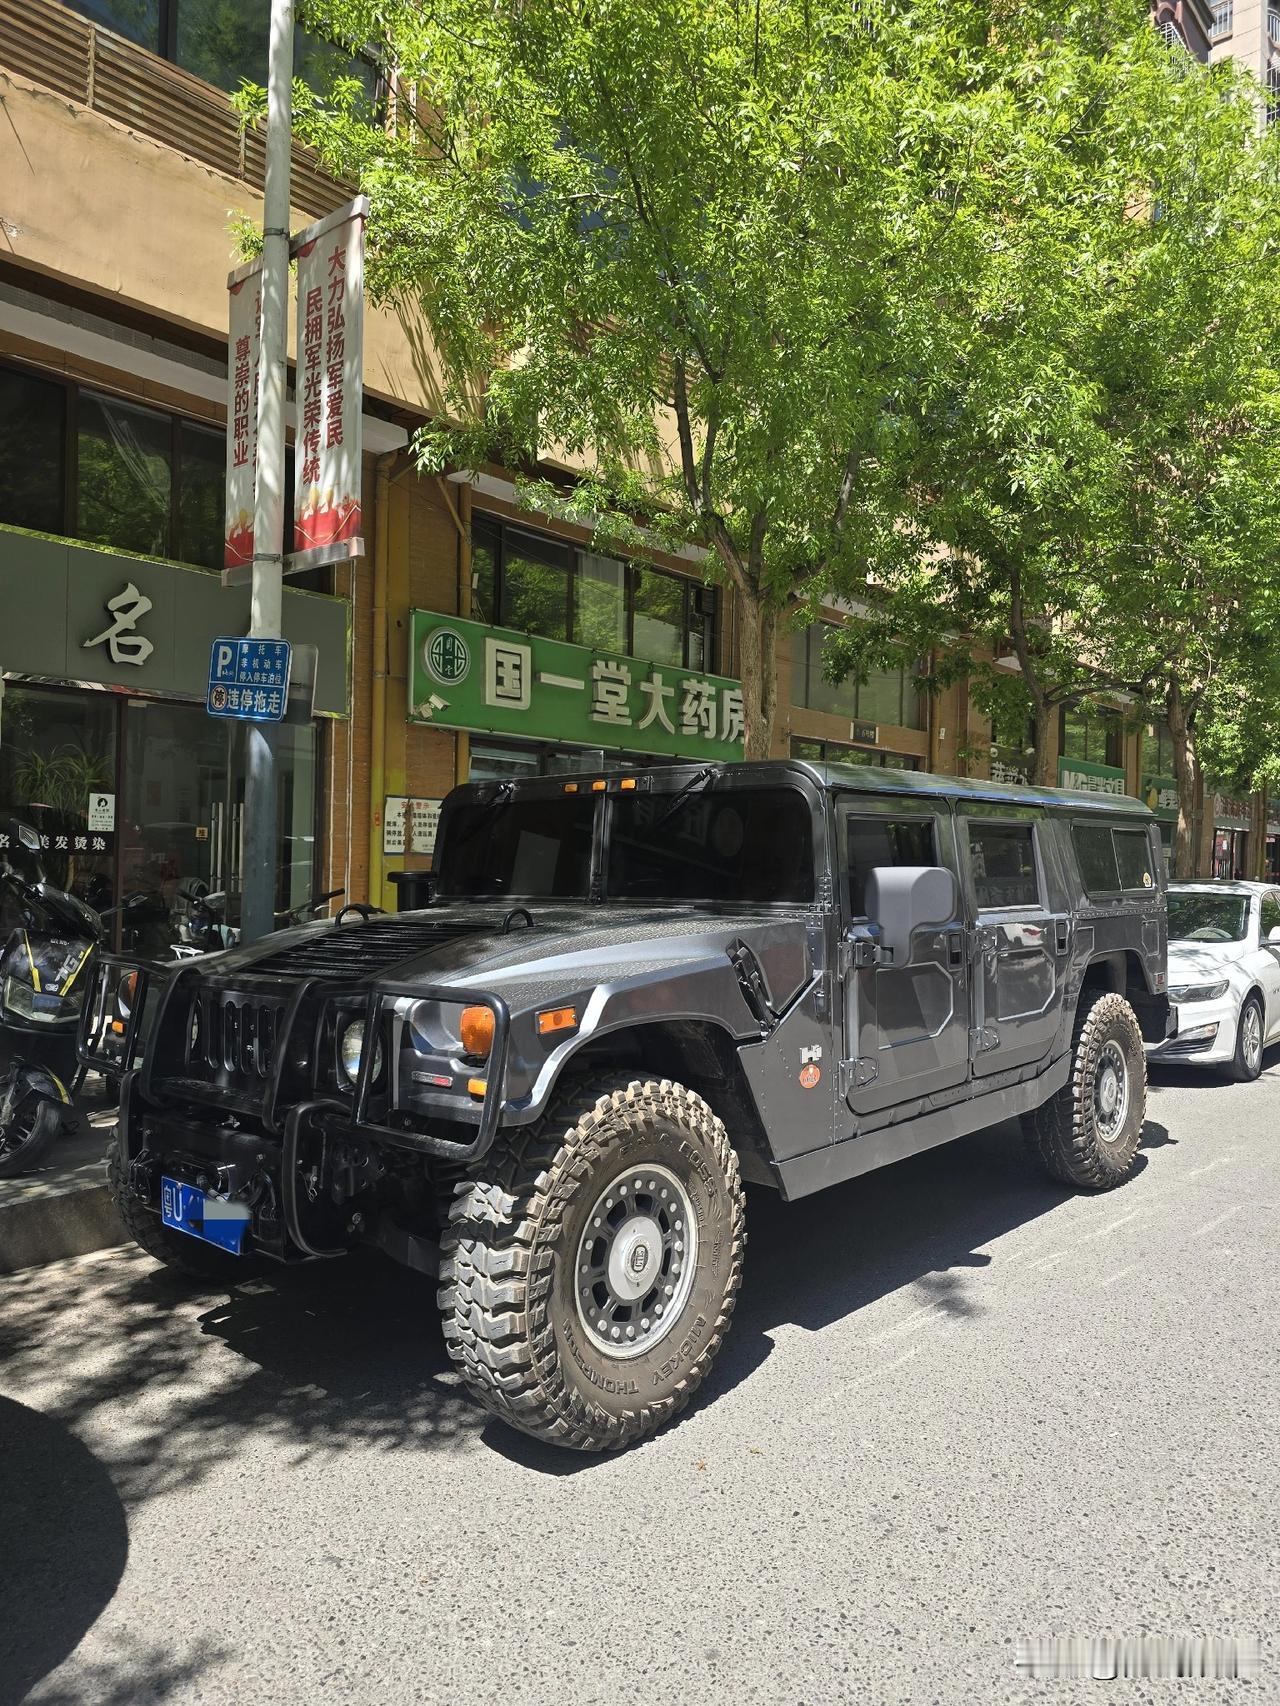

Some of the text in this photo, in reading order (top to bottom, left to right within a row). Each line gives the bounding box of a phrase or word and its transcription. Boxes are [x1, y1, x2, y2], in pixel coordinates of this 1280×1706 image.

[233, 335, 251, 468] 尊崇的职业
[302, 286, 323, 486] 民拥军光荣传统
[326, 245, 347, 450] 大力弘扬军爱民
[82, 582, 154, 666] 名
[217, 645, 233, 678] P
[227, 688, 281, 714] 违停拖走
[482, 636, 745, 745] 国一堂大药房
